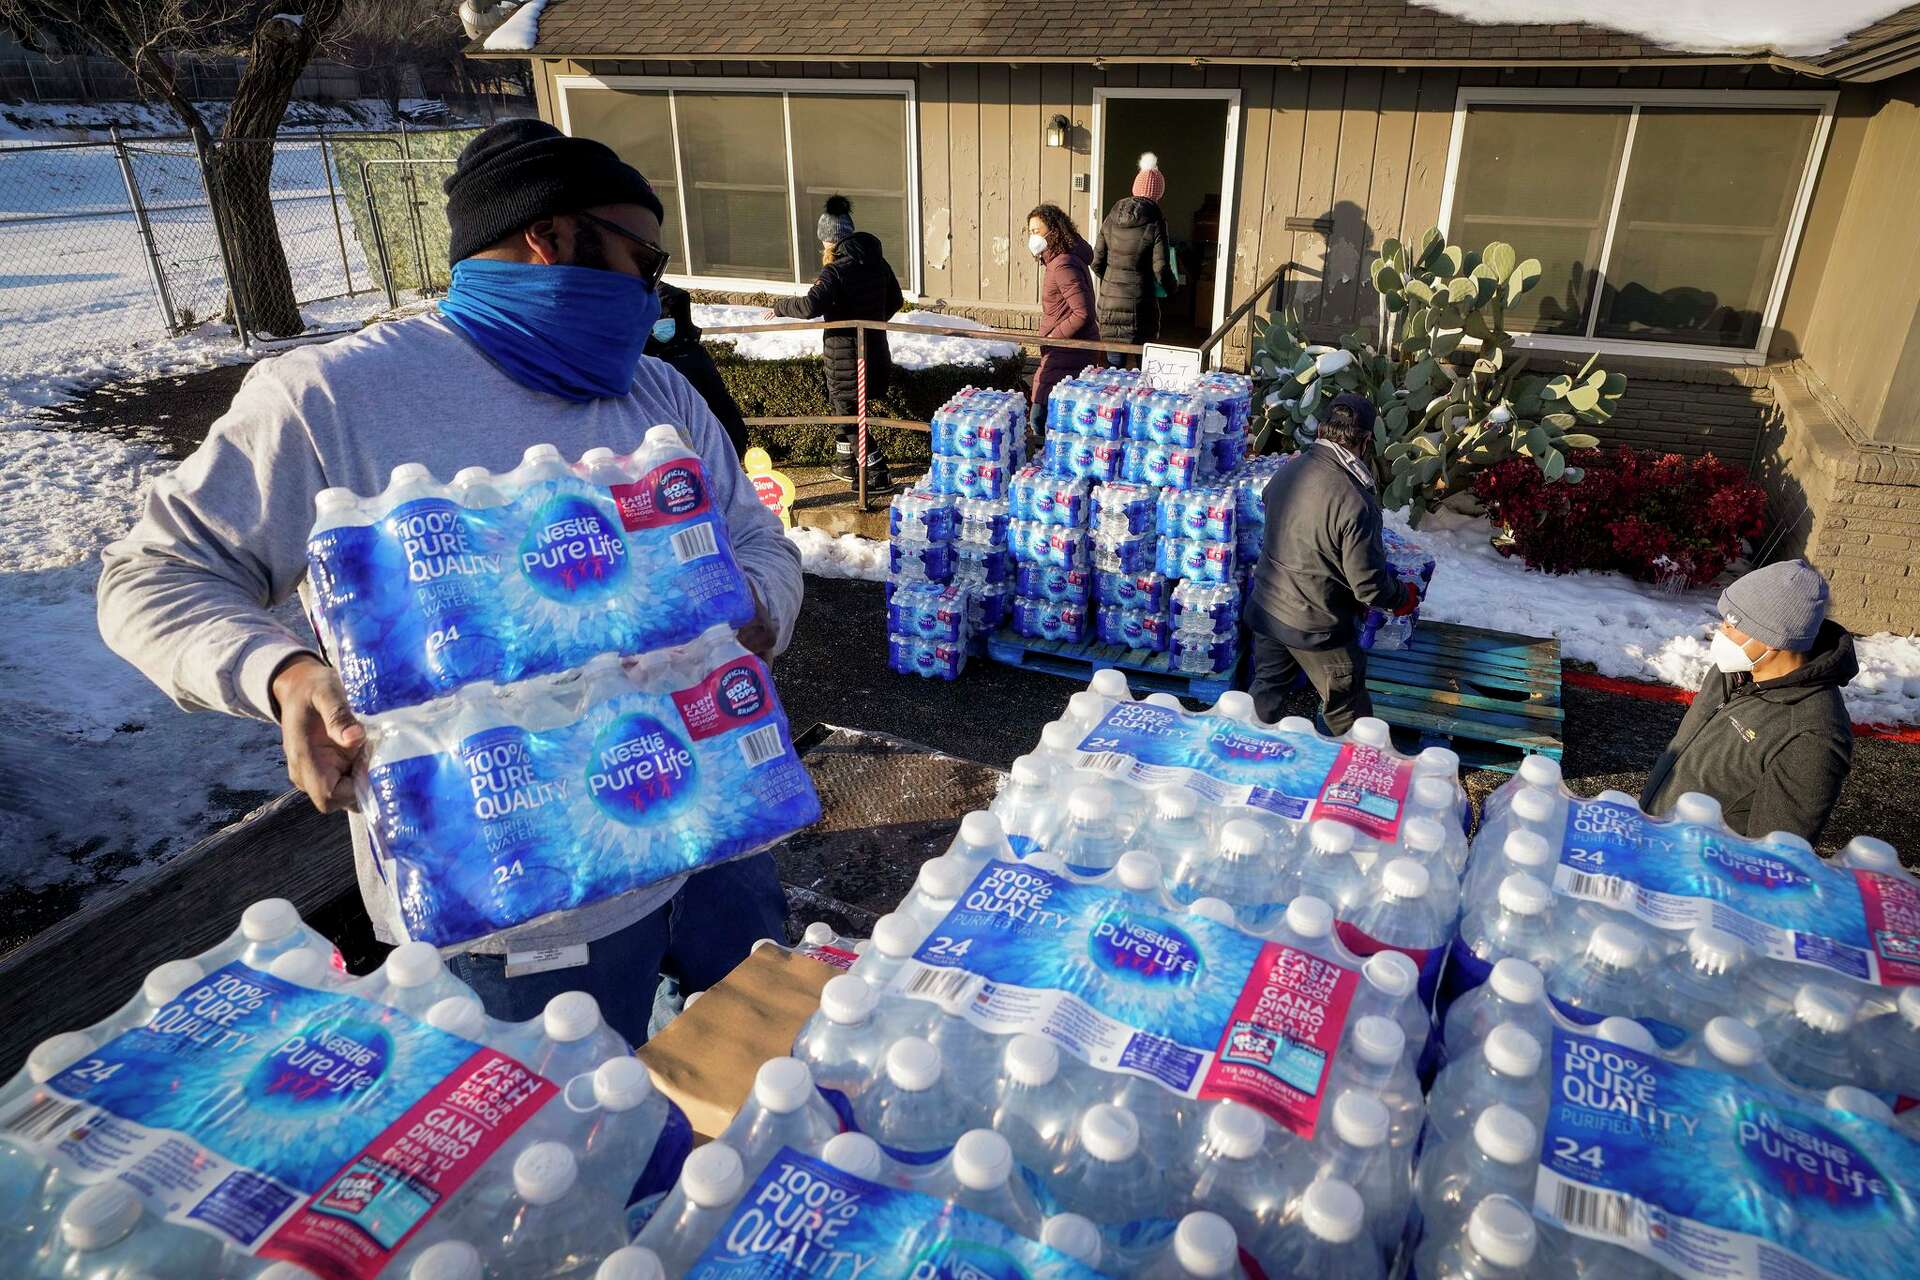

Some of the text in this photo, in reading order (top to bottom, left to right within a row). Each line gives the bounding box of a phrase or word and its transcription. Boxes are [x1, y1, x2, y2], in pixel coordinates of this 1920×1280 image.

[1148, 360, 1190, 376] EXIT
[661, 470, 688, 485] OFFICIAL
[663, 480, 688, 496] BOX
[753, 481, 774, 491] Slow
[621, 490, 650, 504] EARN
[623, 498, 651, 509] CASH
[668, 487, 694, 500] TOPS
[396, 511, 465, 538] 100%
[403, 532, 470, 562] PURE
[522, 534, 625, 573] Pure Life
[409, 553, 501, 582] QUALITY
[430, 625, 461, 650] 24
[722, 669, 748, 686] OFFICIAL
[726, 680, 749, 699] BOX
[683, 692, 712, 711] EARN
[732, 686, 756, 702] TOPS
[687, 702, 714, 717] CASH
[1117, 709, 1167, 728] PURE
[1125, 705, 1173, 723] 100%
[1108, 717, 1190, 738] QUALITY
[1088, 738, 1120, 748] 24
[1211, 733, 1257, 752] Pure
[465, 743, 530, 776] 100%
[589, 748, 692, 795] Pure Life
[1347, 764, 1393, 783] GANA
[471, 764, 535, 798] PURE
[475, 779, 569, 819] QUALITY
[1577, 809, 1640, 832] PURE
[1581, 803, 1642, 825] 100%
[1574, 820, 1674, 851] QUALITY
[1570, 848, 1605, 865] 24
[1703, 847, 1760, 875] Pure
[494, 859, 524, 884] 24
[991, 867, 1052, 897] 100%
[979, 877, 1043, 911] PURE
[966, 891, 1071, 929] QUALITY
[928, 936, 973, 956] 24
[1094, 921, 1150, 958] Pure
[1154, 948, 1197, 975] Life
[1277, 956, 1337, 988] CASH
[1281, 948, 1341, 979] EARN
[212, 974, 275, 1011] 100%
[1268, 973, 1331, 1004] SCHOOL
[1300, 975, 1333, 995] YOUR
[185, 987, 250, 1028] PURE
[1258, 998, 1323, 1027] DINERO
[1263, 986, 1325, 1018] GANA
[149, 1004, 256, 1053] QUALITY
[1251, 1014, 1316, 1043] ESCUELA
[1253, 1007, 1319, 1034] PARA TU
[312, 1029, 378, 1067] Nestlé
[72, 1060, 124, 1084] 24
[272, 1036, 376, 1094] Pure Life
[485, 1058, 543, 1094] EARN
[1240, 1067, 1255, 1078] NO
[1564, 1040, 1656, 1086] 100%
[471, 1069, 529, 1106] CASH
[1564, 1054, 1656, 1104] PURE
[446, 1091, 503, 1127] SCHOOL
[484, 1088, 513, 1114] YOUR
[1562, 1076, 1699, 1137] QUALITY
[424, 1108, 483, 1147] GANA
[1561, 1107, 1632, 1135] PURIFIED
[395, 1137, 455, 1170] PARA TU
[407, 1123, 469, 1160] DINERO
[1554, 1137, 1604, 1168] 24
[382, 1147, 441, 1184] ESCUELA
[1739, 1121, 1889, 1198] Pure Life
[777, 1164, 861, 1218] 100%
[756, 1182, 849, 1249] PURE
[726, 1209, 877, 1280] QUALITY
